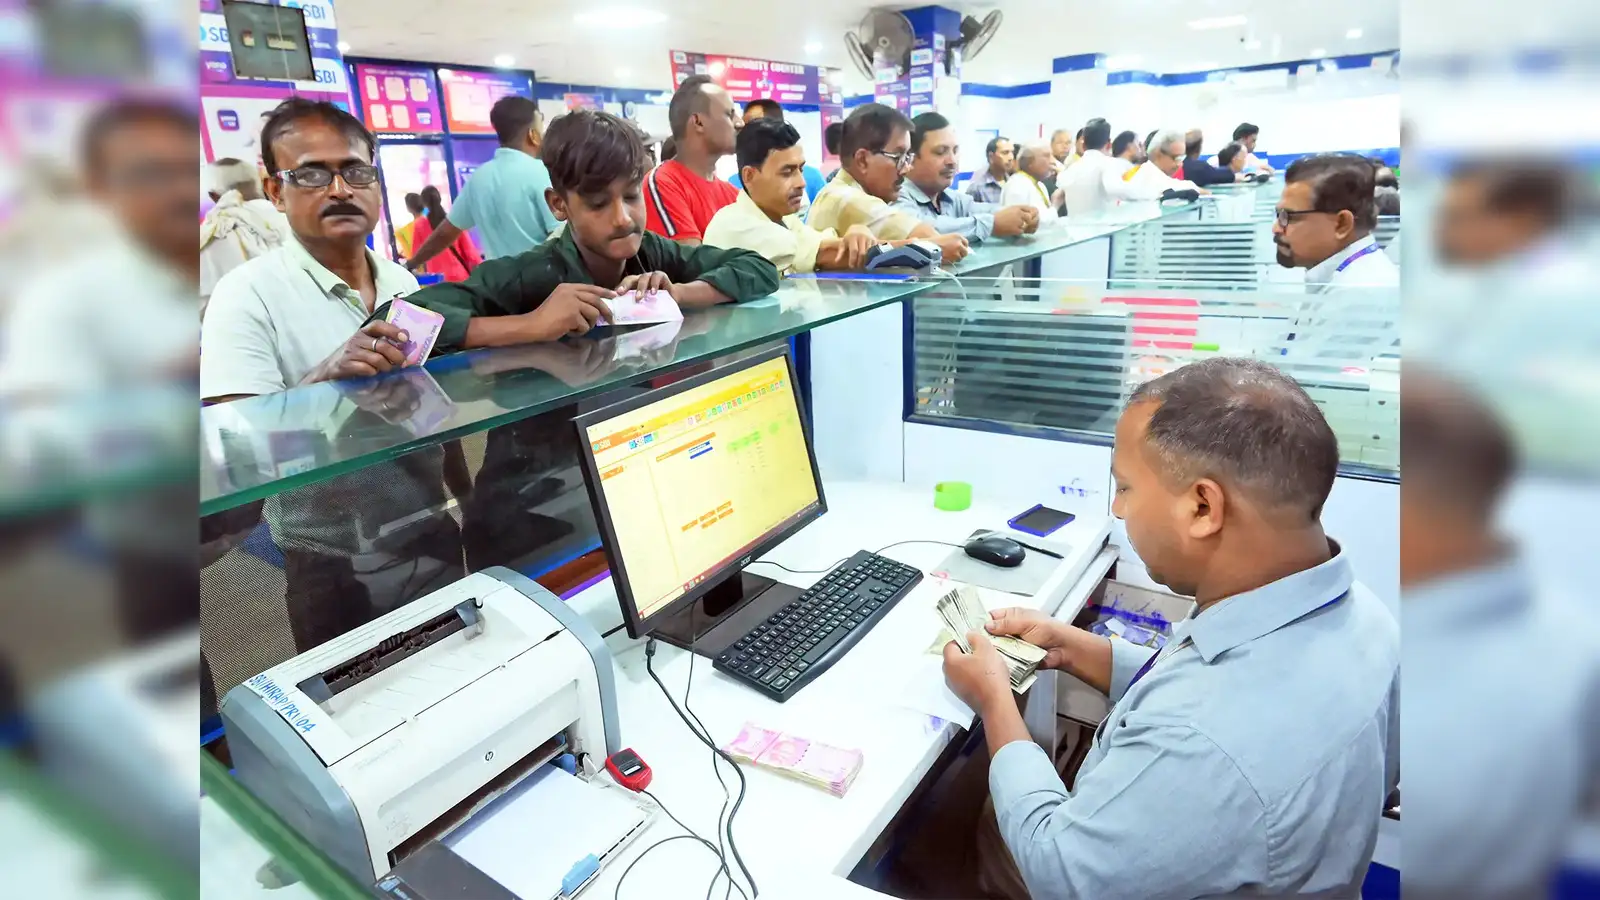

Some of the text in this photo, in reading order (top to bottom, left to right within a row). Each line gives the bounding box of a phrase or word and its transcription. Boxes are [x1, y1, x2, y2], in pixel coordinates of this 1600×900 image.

[302, 3, 326, 20] SBI
[208, 27, 230, 43] SB
[314, 69, 337, 84] SBI
